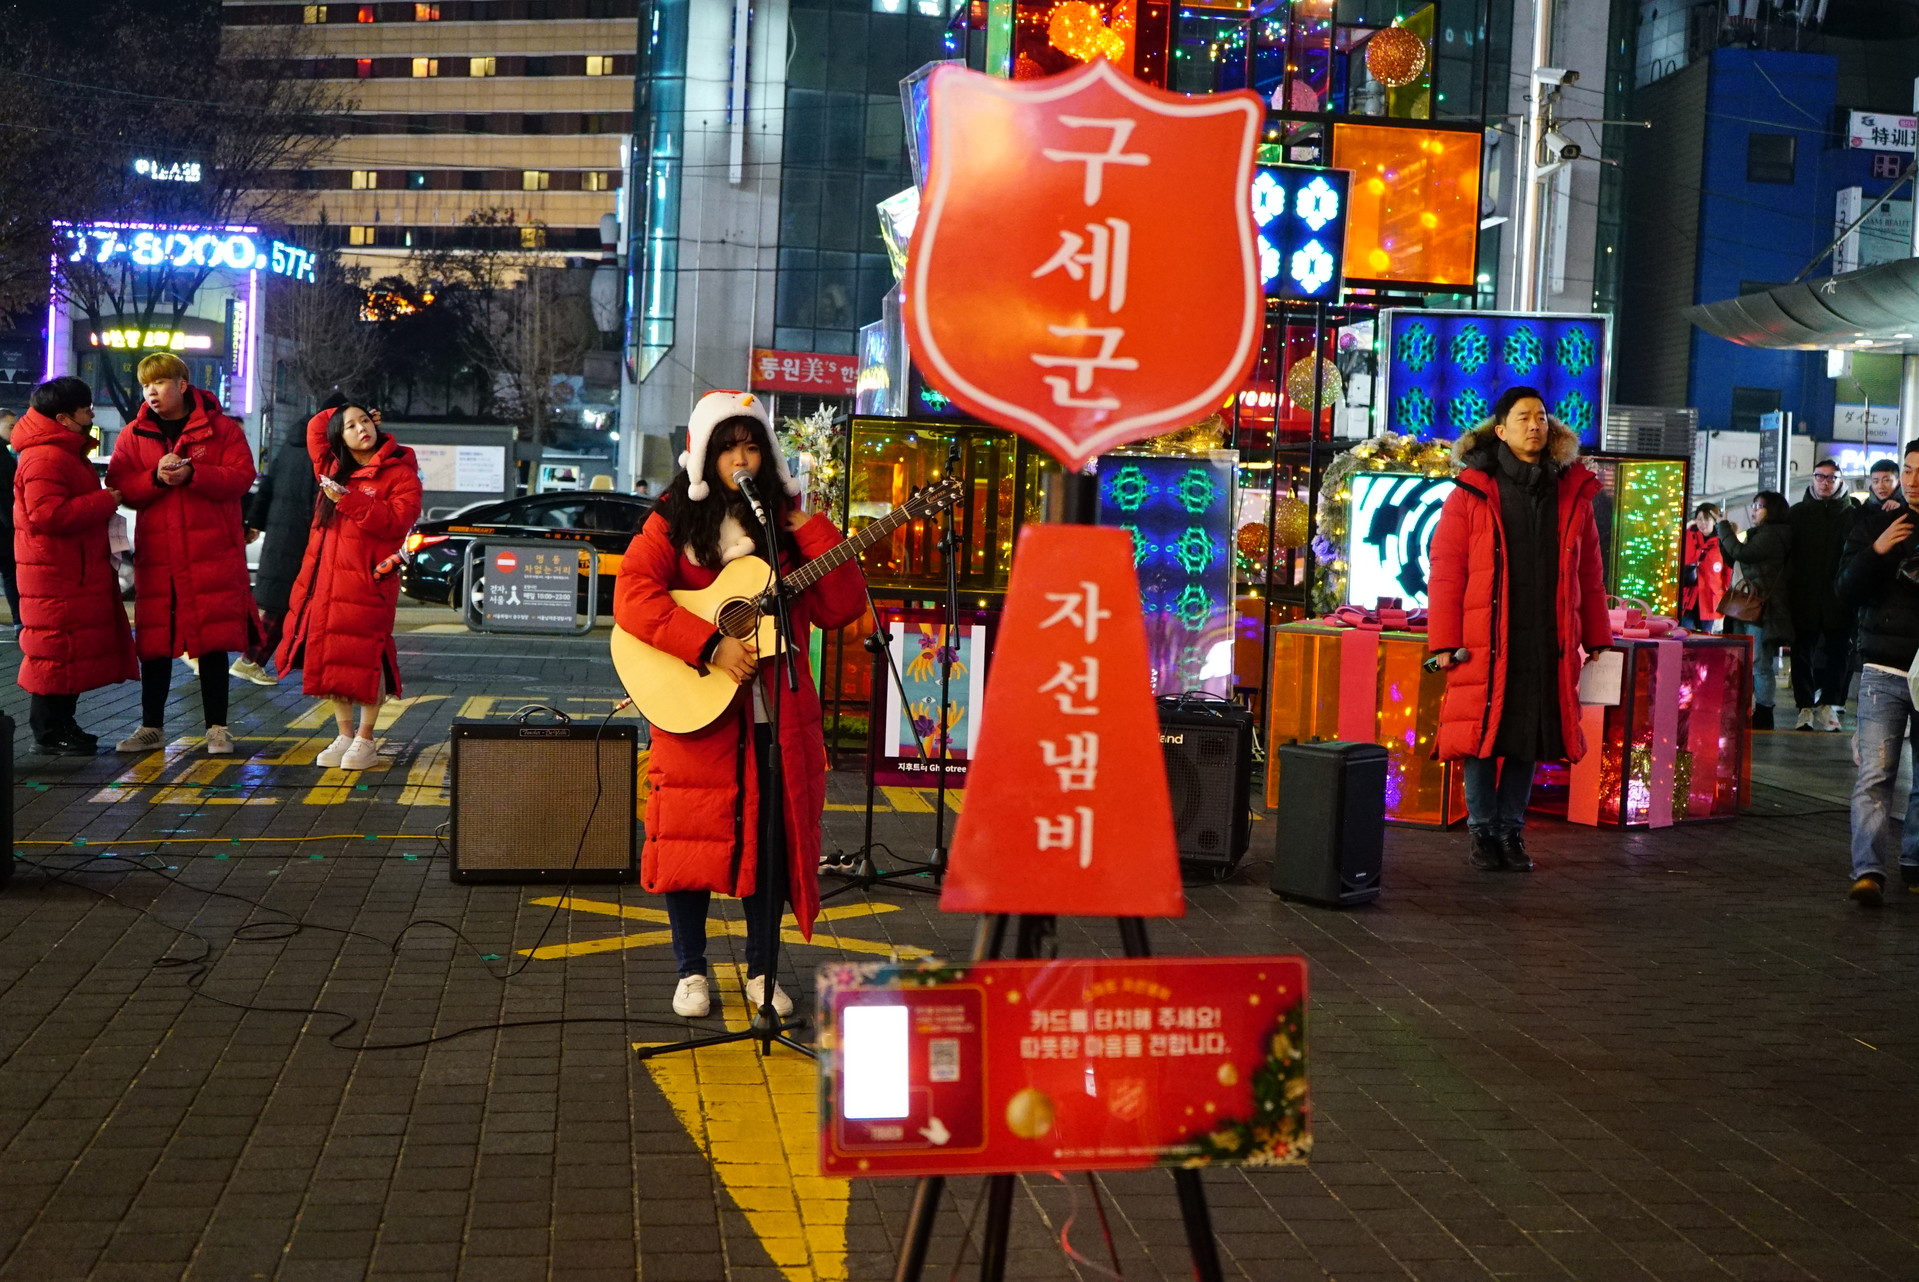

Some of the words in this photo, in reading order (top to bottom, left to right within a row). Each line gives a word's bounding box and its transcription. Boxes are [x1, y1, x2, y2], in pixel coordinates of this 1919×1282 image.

[1031, 114, 1151, 412] 구세군
[1034, 580, 1112, 869] 자선냄비
[1158, 733, 1184, 745] land
[929, 764, 967, 773] Ghotree
[1030, 1008, 1089, 1033] 카드를
[1093, 1007, 1152, 1031] 터치해
[1157, 1005, 1222, 1030] 주세요!
[1020, 1036, 1080, 1060] 따뜻한
[1084, 1034, 1143, 1059] 마음을
[1149, 1032, 1231, 1057] 전합니다.
